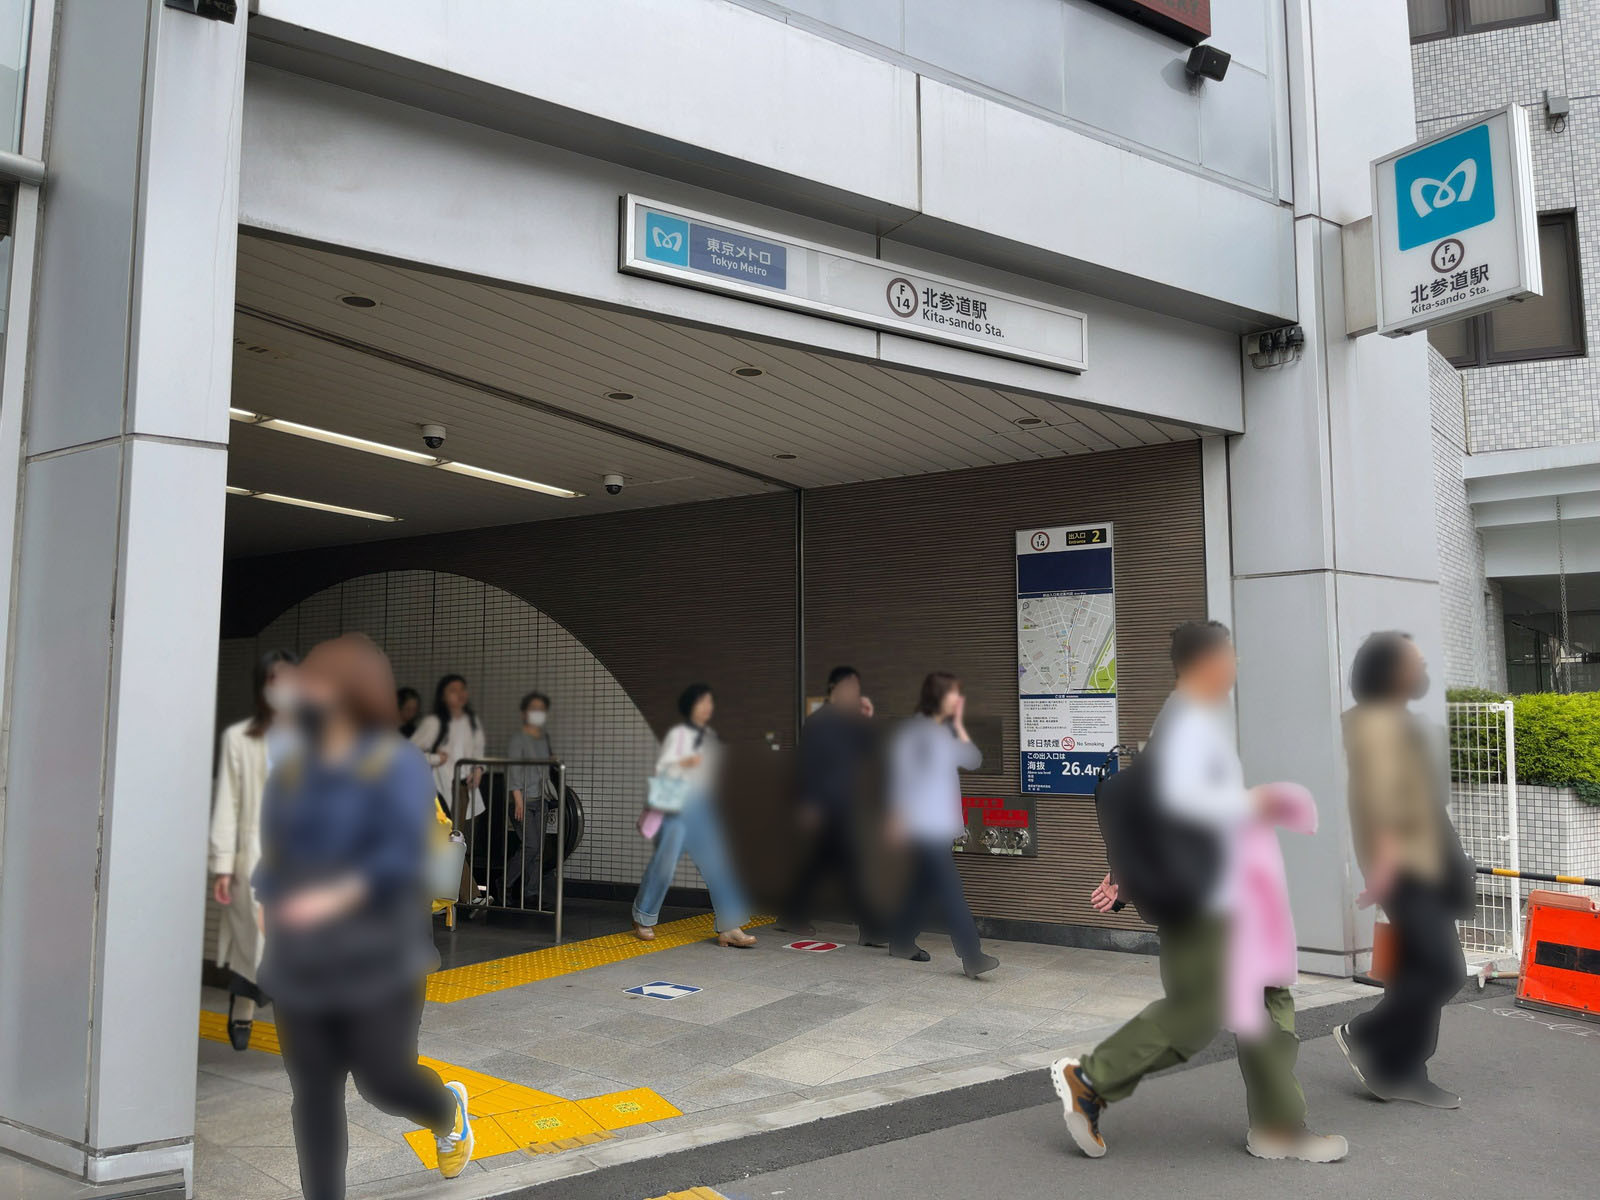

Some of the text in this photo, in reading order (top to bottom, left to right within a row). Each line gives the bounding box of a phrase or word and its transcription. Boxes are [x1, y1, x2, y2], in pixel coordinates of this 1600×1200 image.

[706, 237, 771, 265] 東京メトロ
[1444, 244, 1450, 254] F
[710, 254, 767, 277] Tokyo Metro
[1441, 254, 1456, 266] 14
[900, 285, 906, 295] F
[1410, 263, 1490, 304] 北参道駅
[896, 296, 910, 310] 14
[922, 287, 987, 320] 北参道駅
[1411, 285, 1490, 315] Kita-sando Sta.
[922, 308, 1005, 338] Kita-sando Sta.
[1091, 530, 1101, 542] 2
[1027, 739, 1060, 748] 終日禁煙
[1084, 741, 1105, 749] Smoking
[1027, 752, 1066, 760] この出入口は
[1027, 761, 1046, 770] 海抜
[1061, 761, 1106, 776] 26.4m
